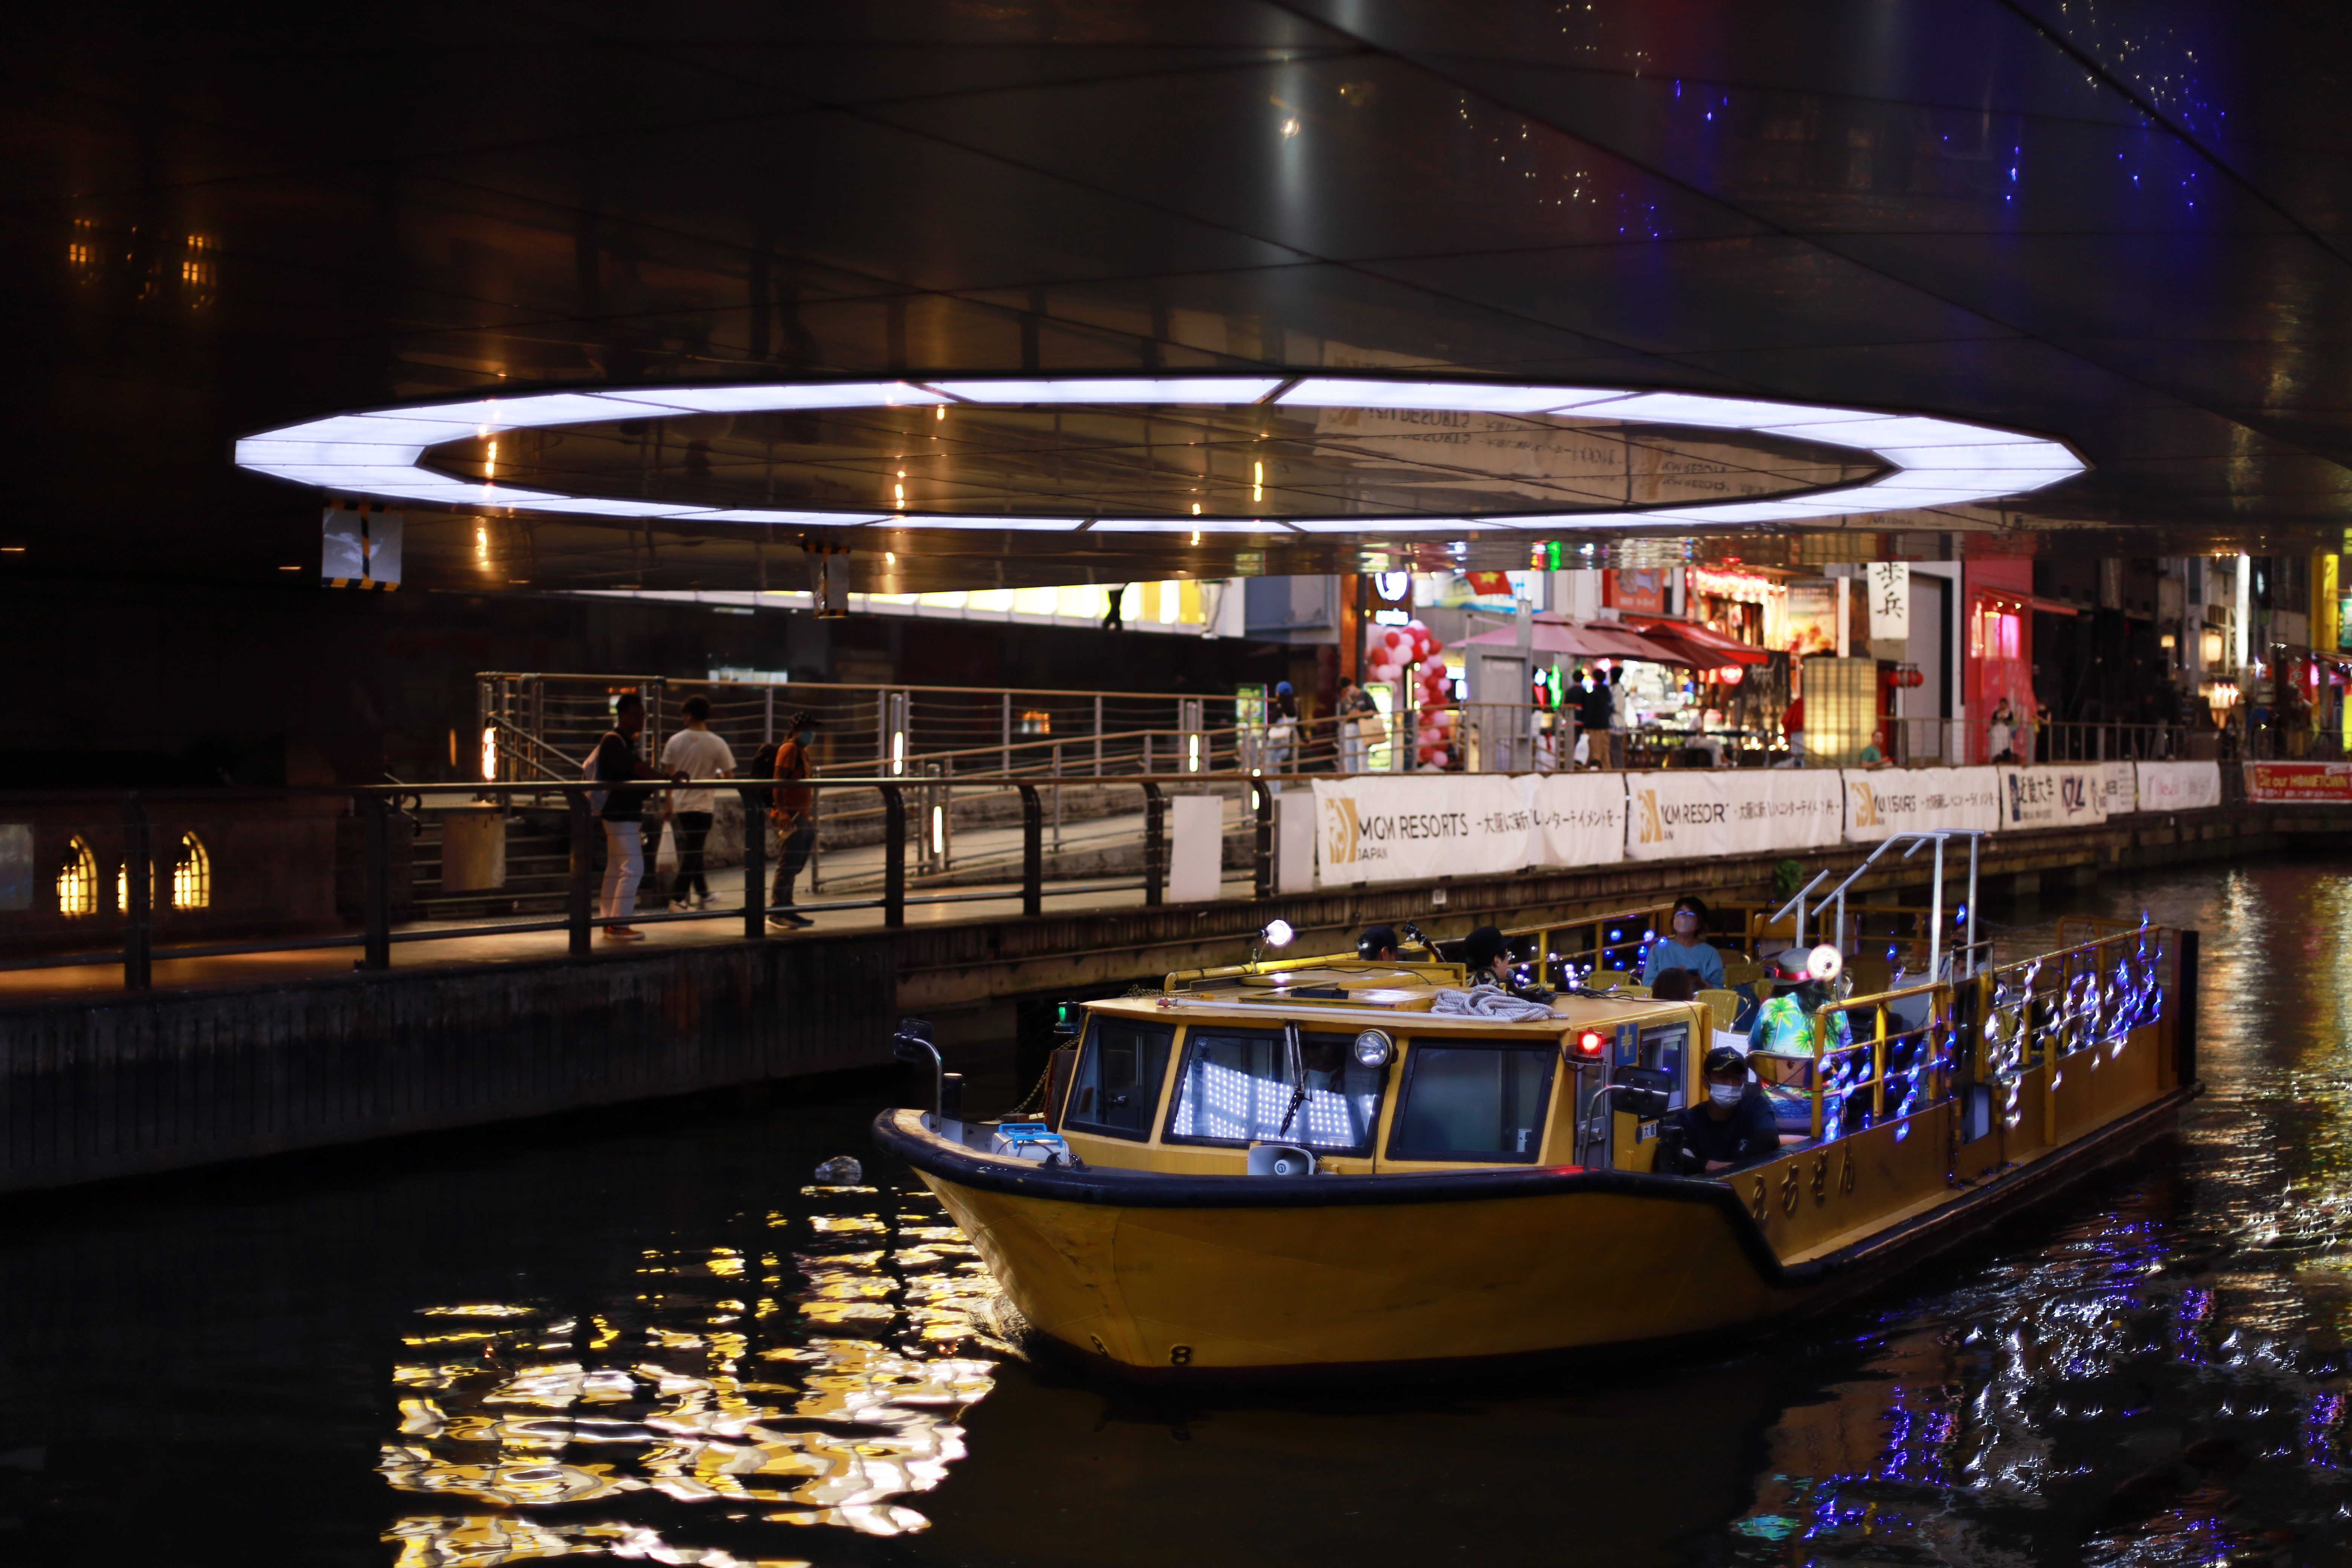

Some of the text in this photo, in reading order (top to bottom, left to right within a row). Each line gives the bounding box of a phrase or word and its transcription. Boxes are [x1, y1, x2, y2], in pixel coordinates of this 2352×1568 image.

[1683, 803, 1729, 824] RESOR
[1357, 813, 1468, 841] MGM RESORTS
[1357, 847, 1388, 861] JAPAN
[1170, 1345, 1193, 1366] 8
